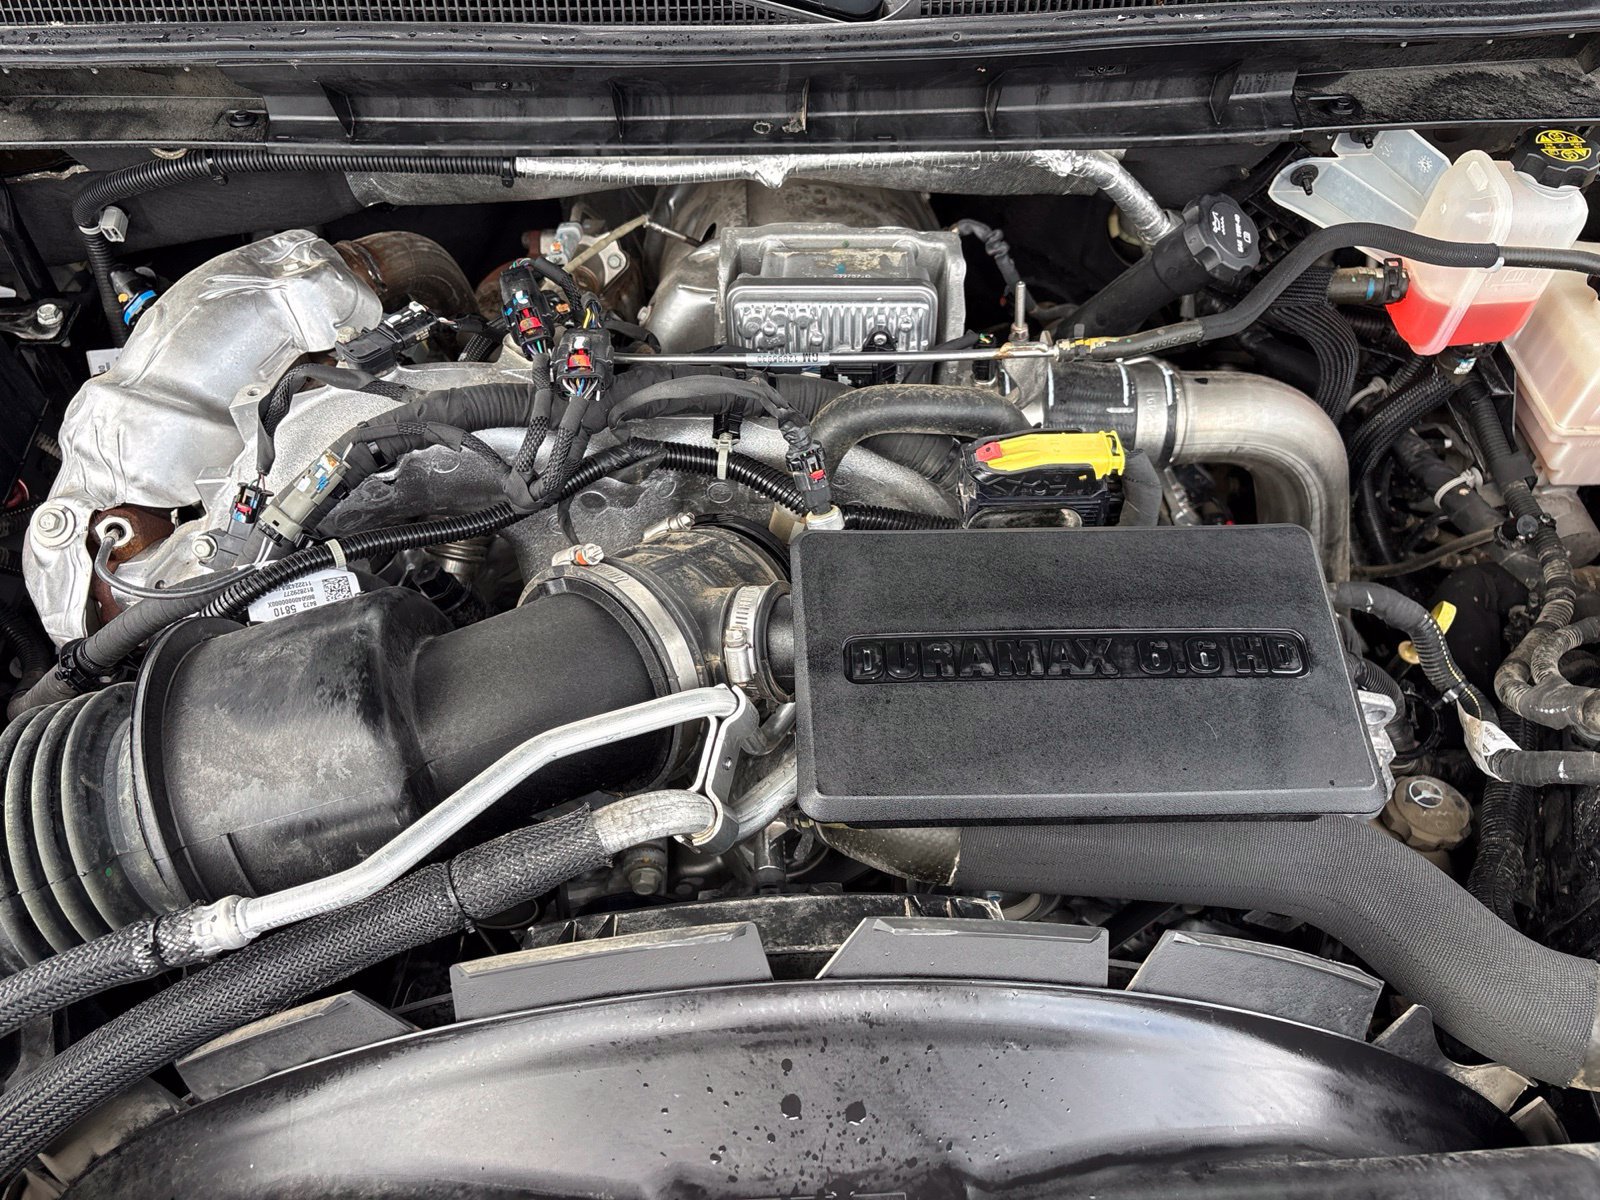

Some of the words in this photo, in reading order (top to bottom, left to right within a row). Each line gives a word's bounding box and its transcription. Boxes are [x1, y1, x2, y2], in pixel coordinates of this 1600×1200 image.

[273, 604, 297, 617] 5810
[849, 636, 1120, 679] DURAMAX
[1137, 636, 1222, 676] 6.6
[1231, 634, 1305, 675] HD
